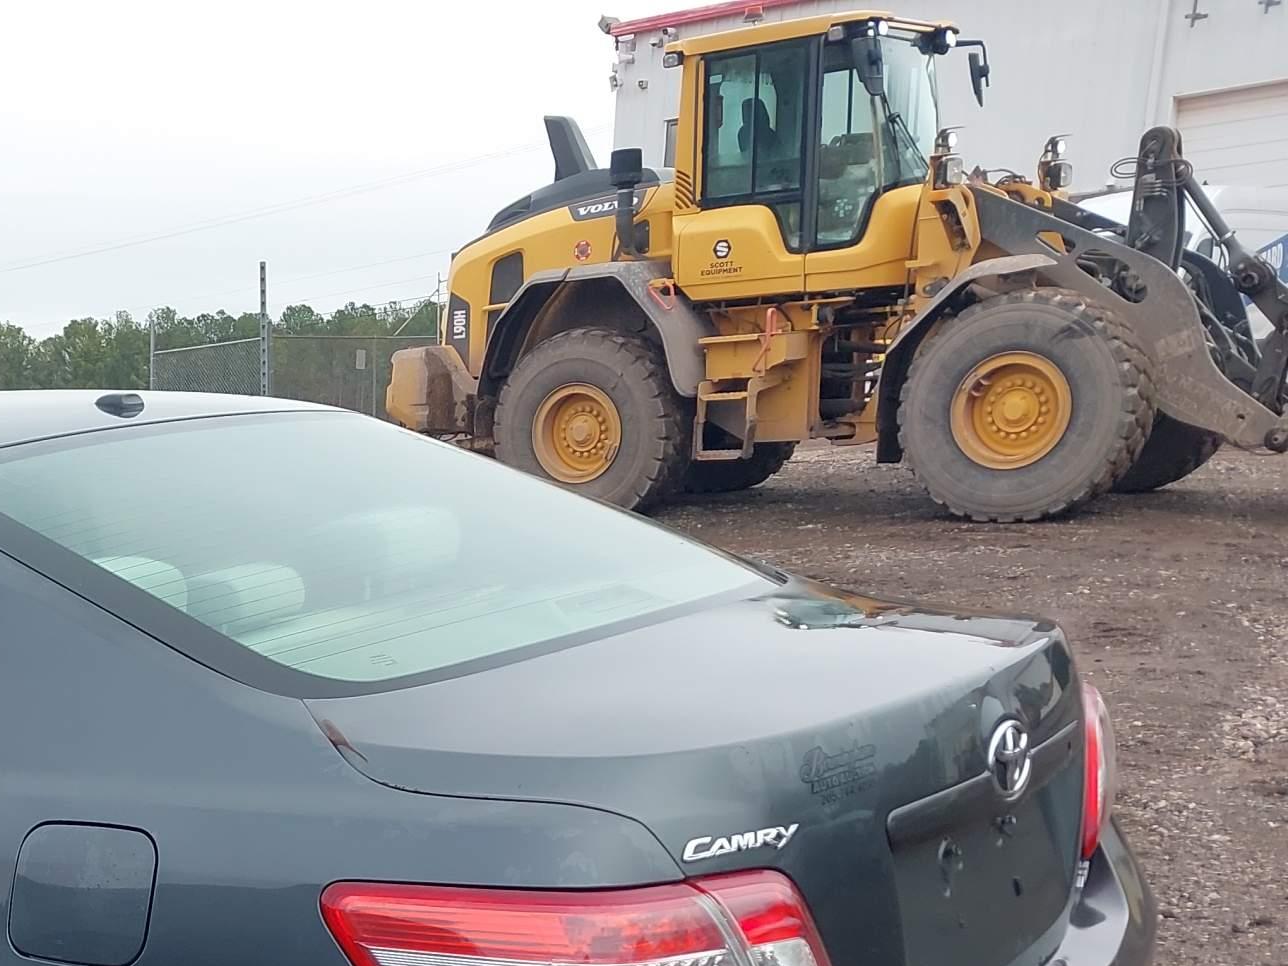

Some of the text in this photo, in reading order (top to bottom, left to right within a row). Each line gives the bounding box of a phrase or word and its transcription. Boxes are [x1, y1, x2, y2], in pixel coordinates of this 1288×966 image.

[700, 266, 744, 277] EQUIPMENT
[709, 260, 734, 269] SCOTT
[453, 310, 466, 339] L90H
[682, 823, 800, 861] CAMRY
